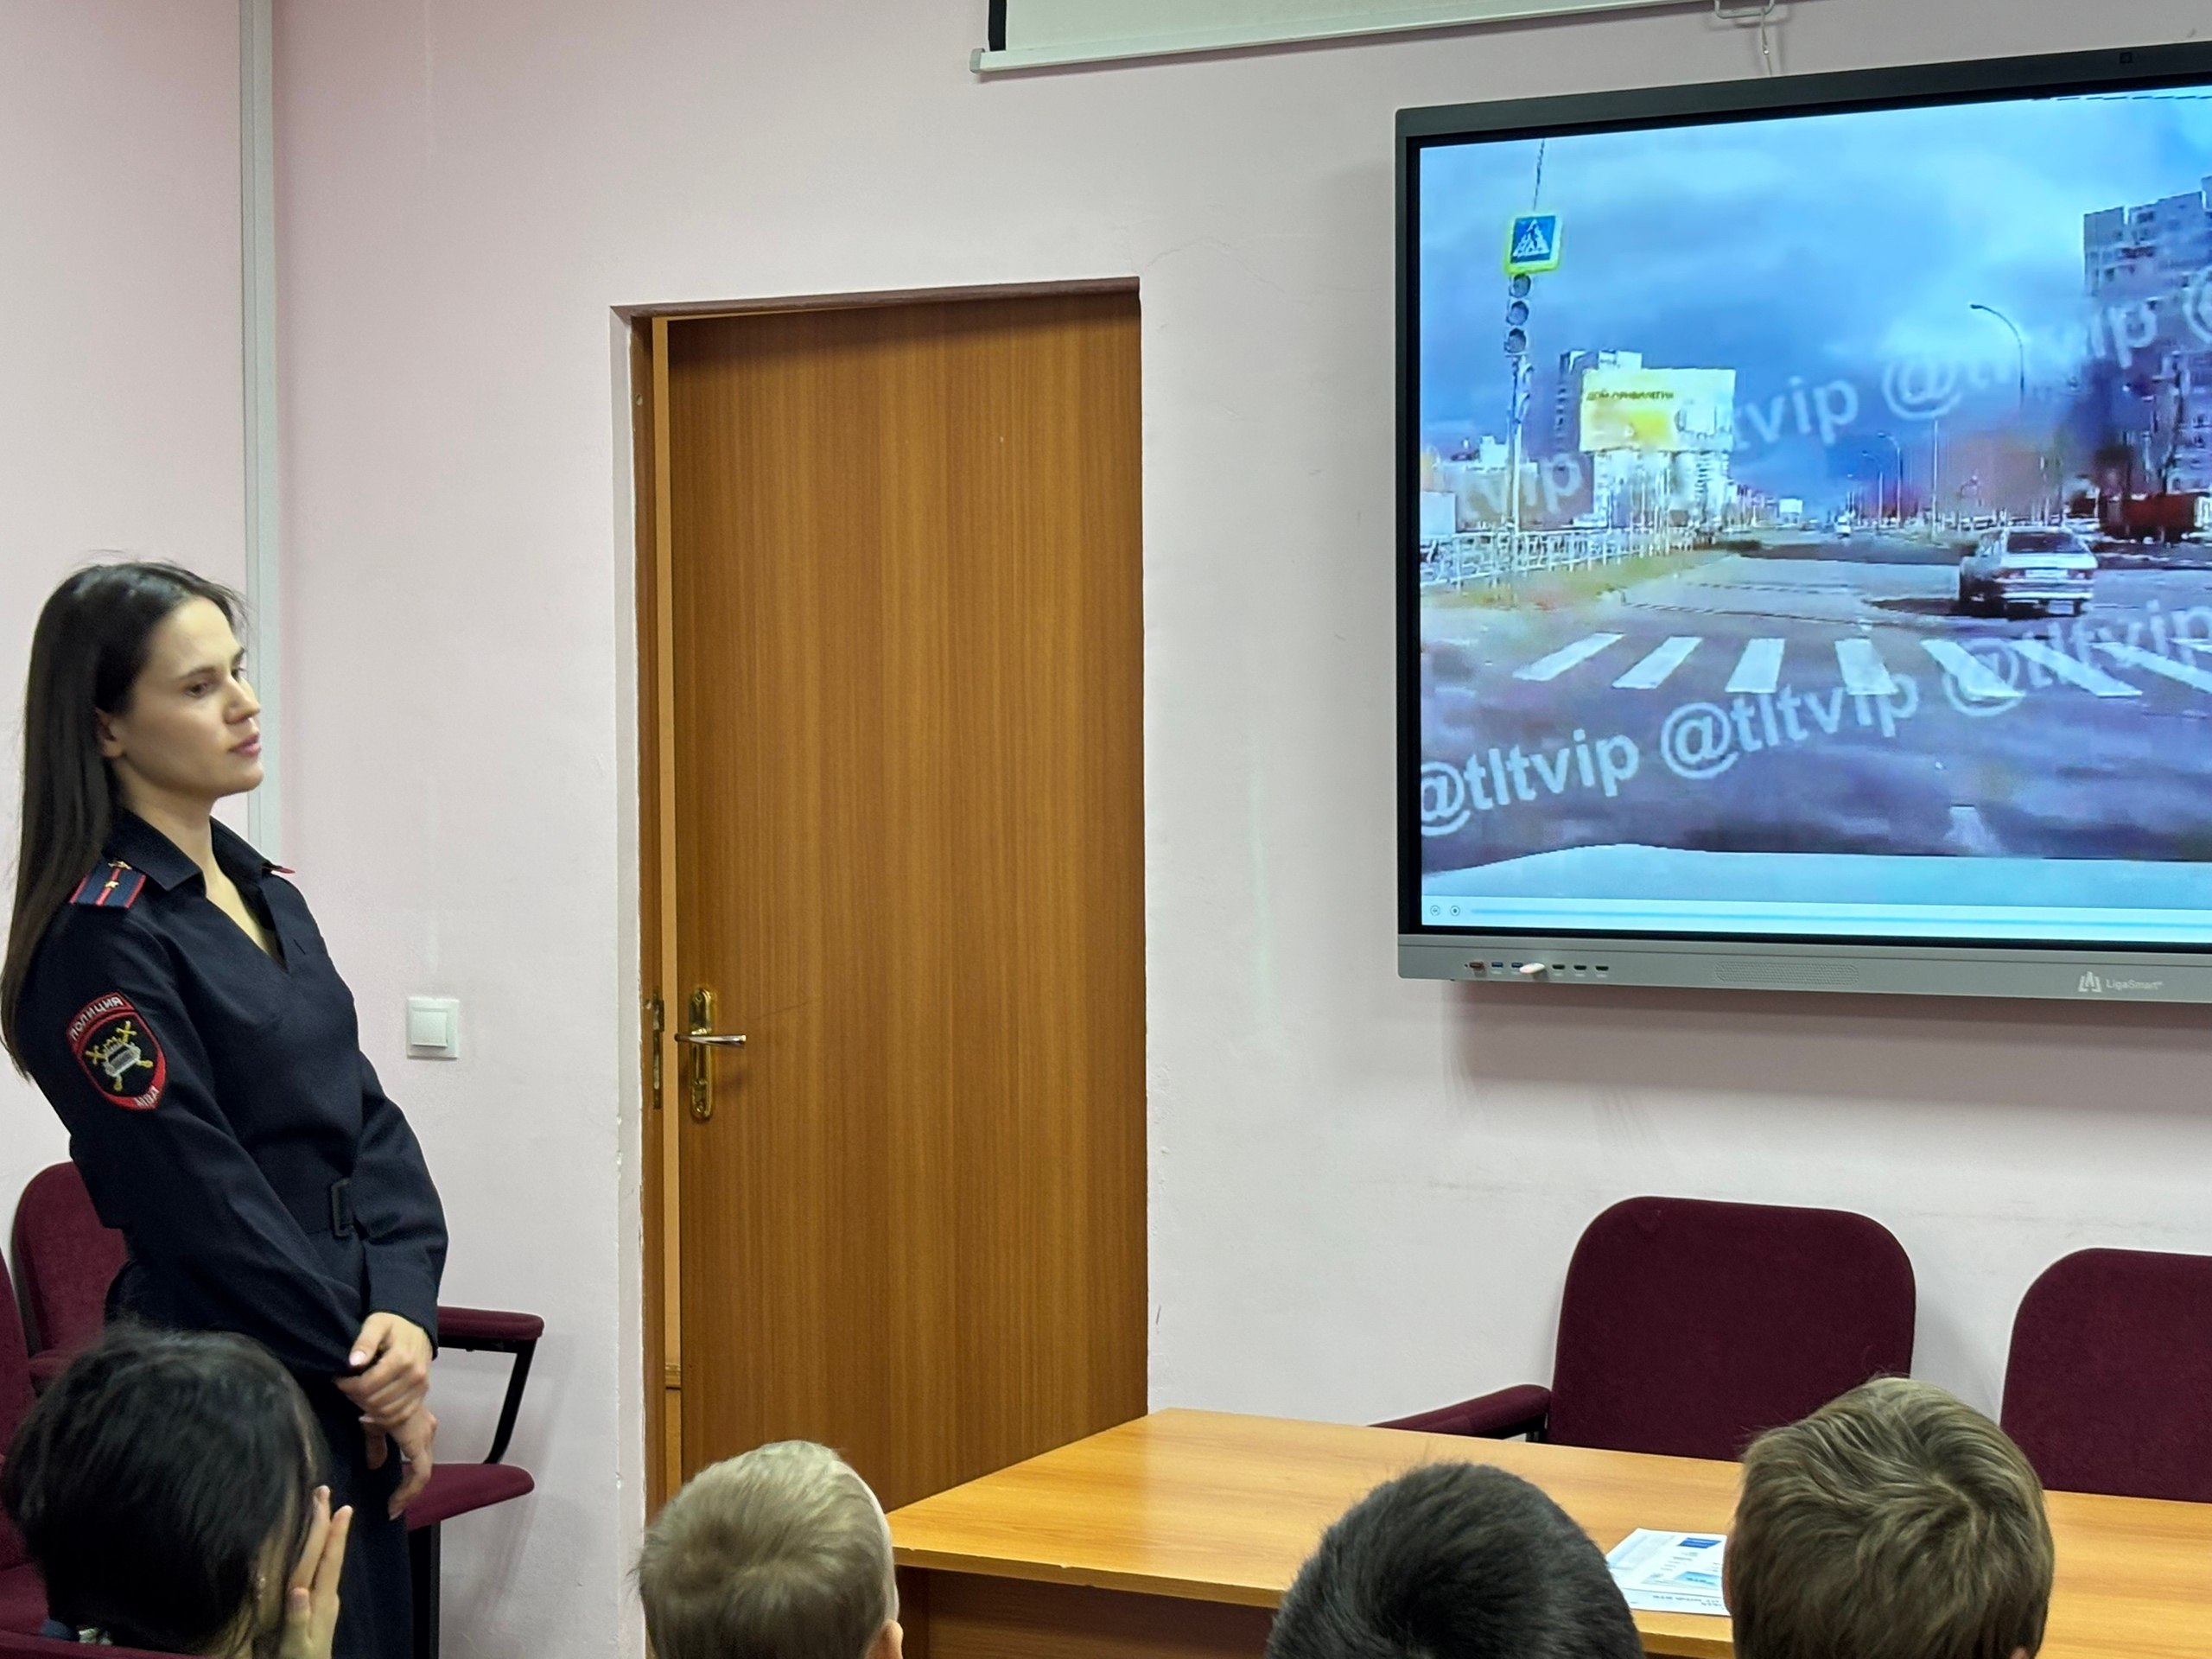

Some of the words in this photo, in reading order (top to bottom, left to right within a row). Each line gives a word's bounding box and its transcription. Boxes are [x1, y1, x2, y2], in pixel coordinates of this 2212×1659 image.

[1421, 728, 1641, 837] @tltvip
[1660, 673, 1920, 779] @tltvip
[69, 996, 124, 1041] ПОЛИЦИЯ
[133, 1084, 160, 1108] МВД
